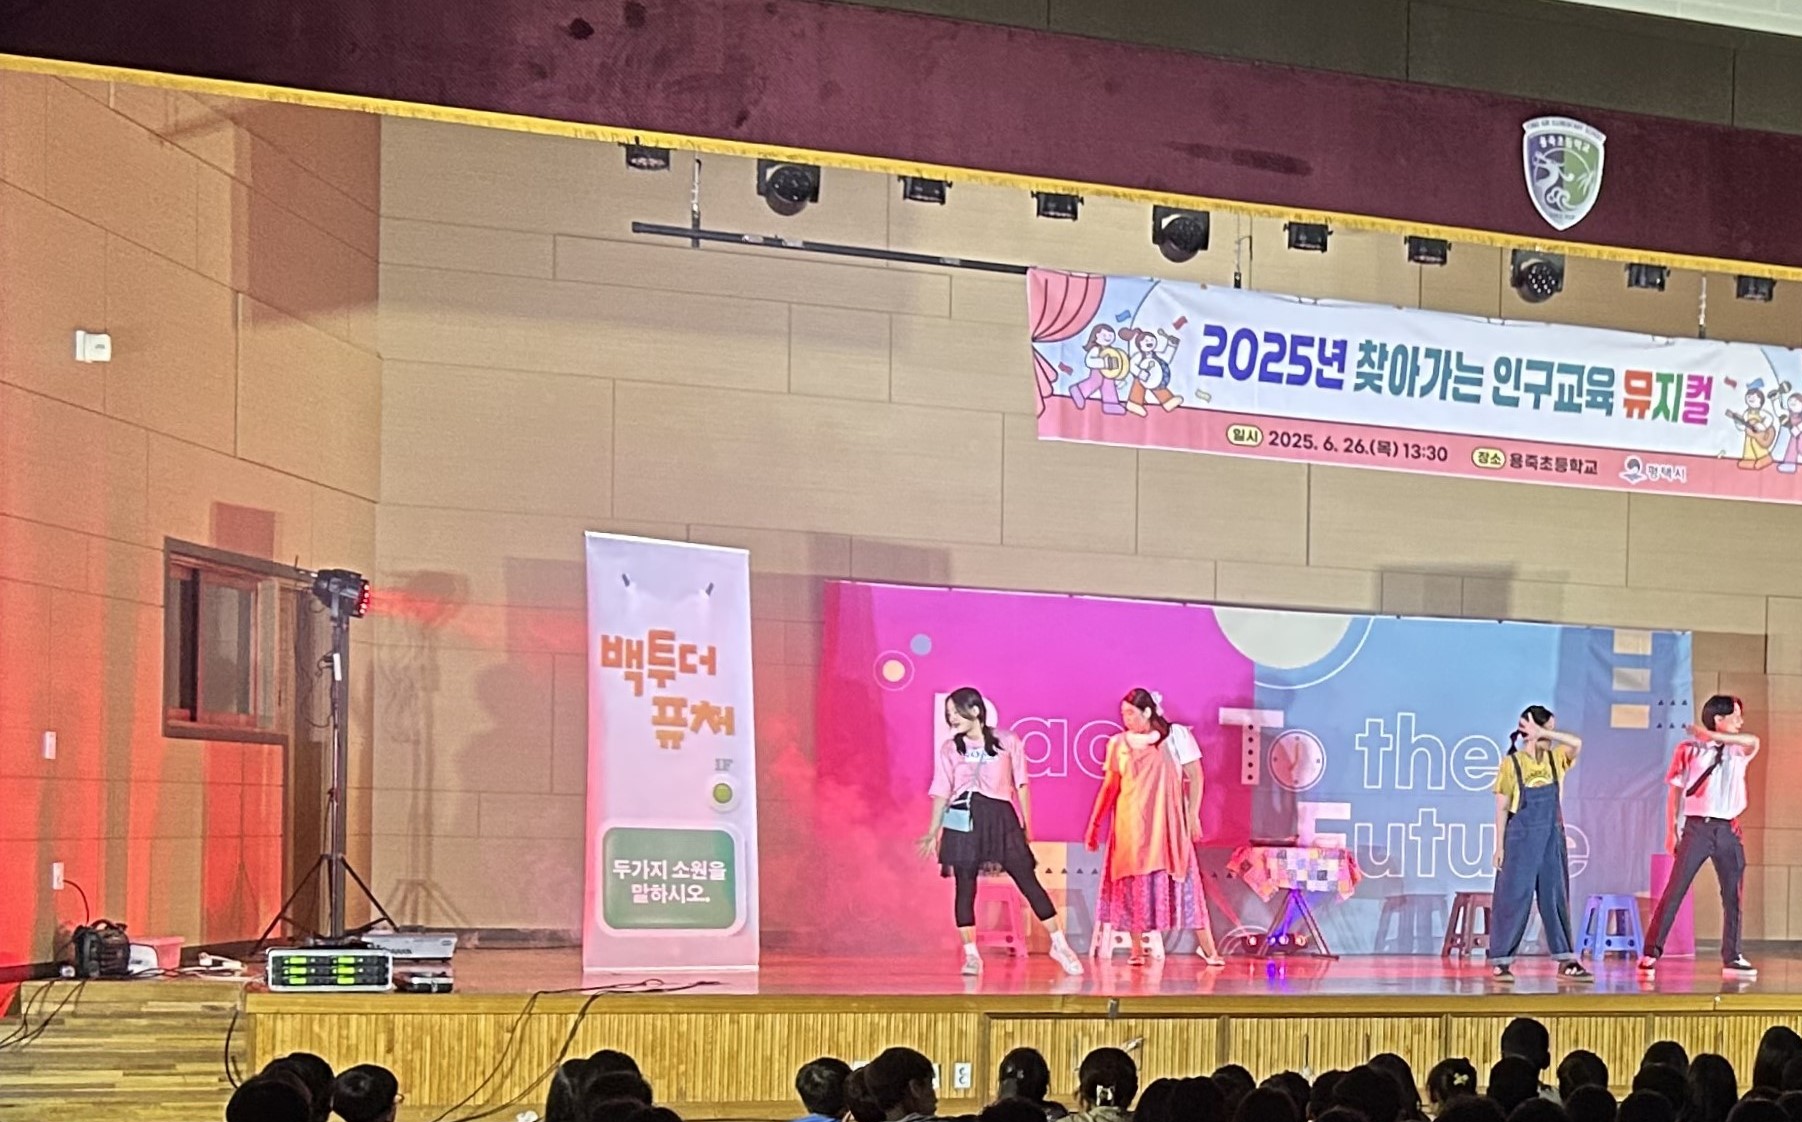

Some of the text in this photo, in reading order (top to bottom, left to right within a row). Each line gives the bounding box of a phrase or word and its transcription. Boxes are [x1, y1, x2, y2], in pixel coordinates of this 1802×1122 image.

[1198, 323, 1714, 426] 2025년 찾아가는 인구교육 뮤지컬
[1232, 428, 1259, 443] 일시
[1268, 431, 1318, 451] 2025.
[1322, 435, 1339, 453] 6.
[1402, 443, 1449, 462] 13:30
[1477, 451, 1598, 475] 장소 용죽초등학교
[1647, 464, 1687, 482] 평택시
[600, 629, 717, 697] 백투더
[1219, 707, 1327, 792] To
[1355, 712, 1499, 791] the
[1297, 800, 1590, 878] Futue
[612, 859, 727, 881] 두가지 소원을
[631, 883, 711, 904] 말하시오.
